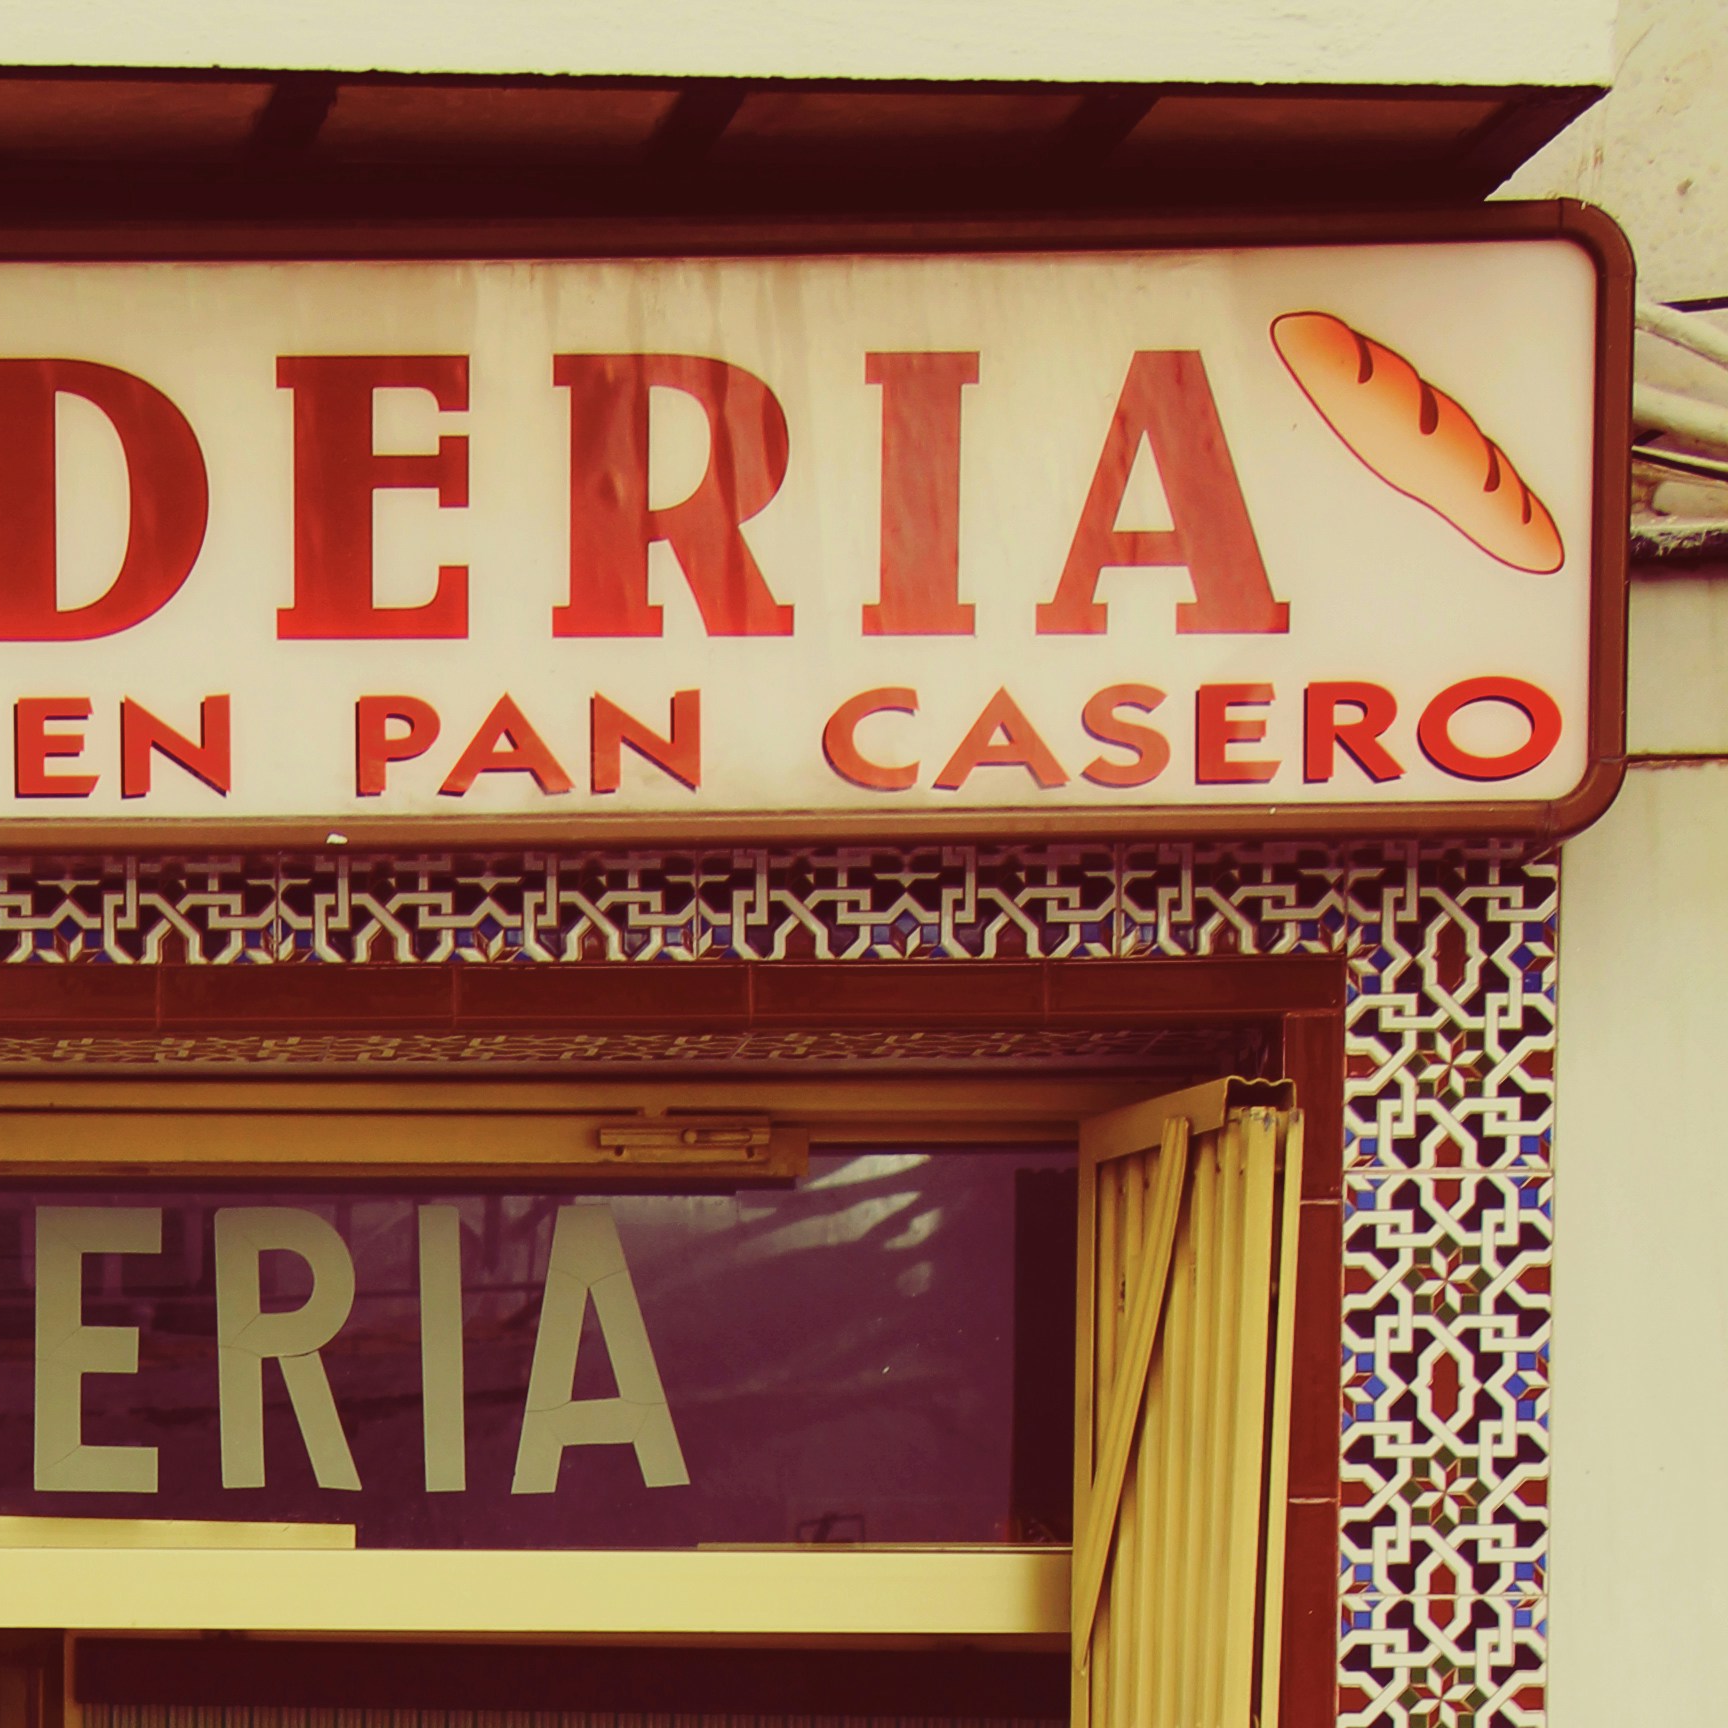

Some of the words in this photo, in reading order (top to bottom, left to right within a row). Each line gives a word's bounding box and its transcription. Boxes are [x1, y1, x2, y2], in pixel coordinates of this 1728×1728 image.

[14, 694, 231, 800] EN
[354, 690, 702, 797] PAN
[821, 676, 1563, 792] CASERO
